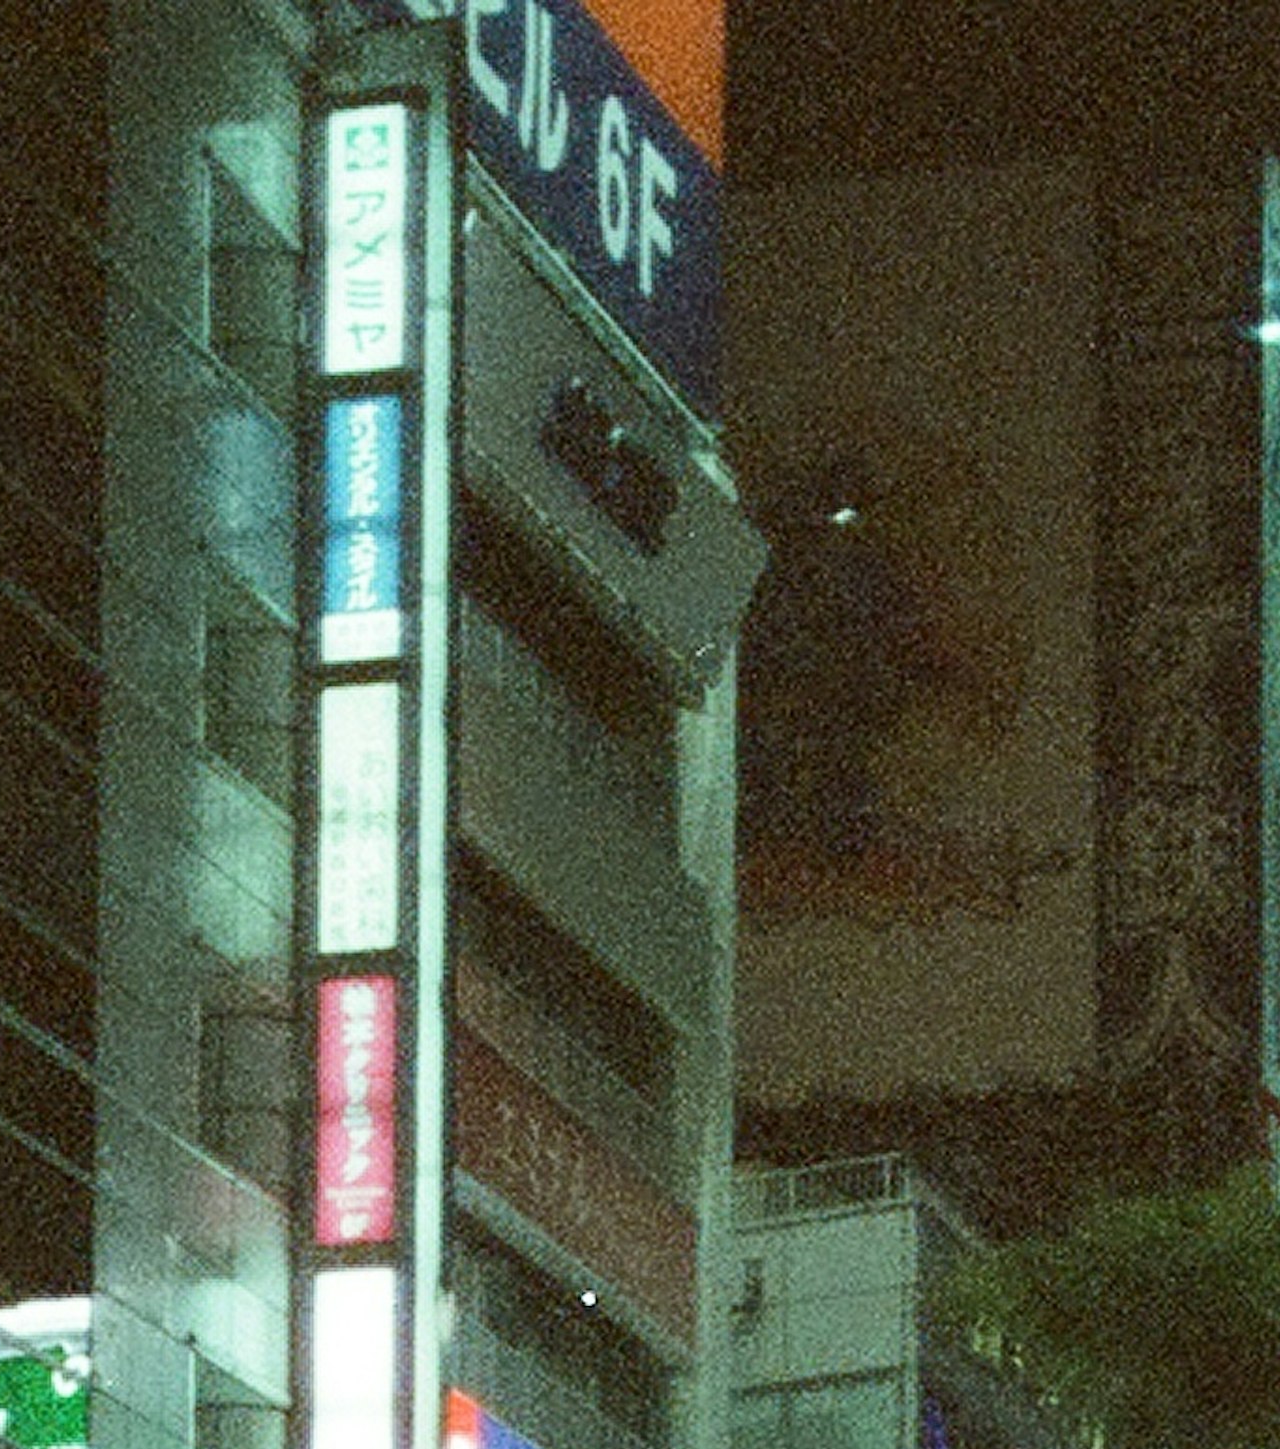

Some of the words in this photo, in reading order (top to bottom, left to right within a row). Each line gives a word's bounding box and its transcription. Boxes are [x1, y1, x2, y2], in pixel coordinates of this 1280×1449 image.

[344, 188, 389, 354] アメミヤ
[597, 94, 677, 297] 6F
